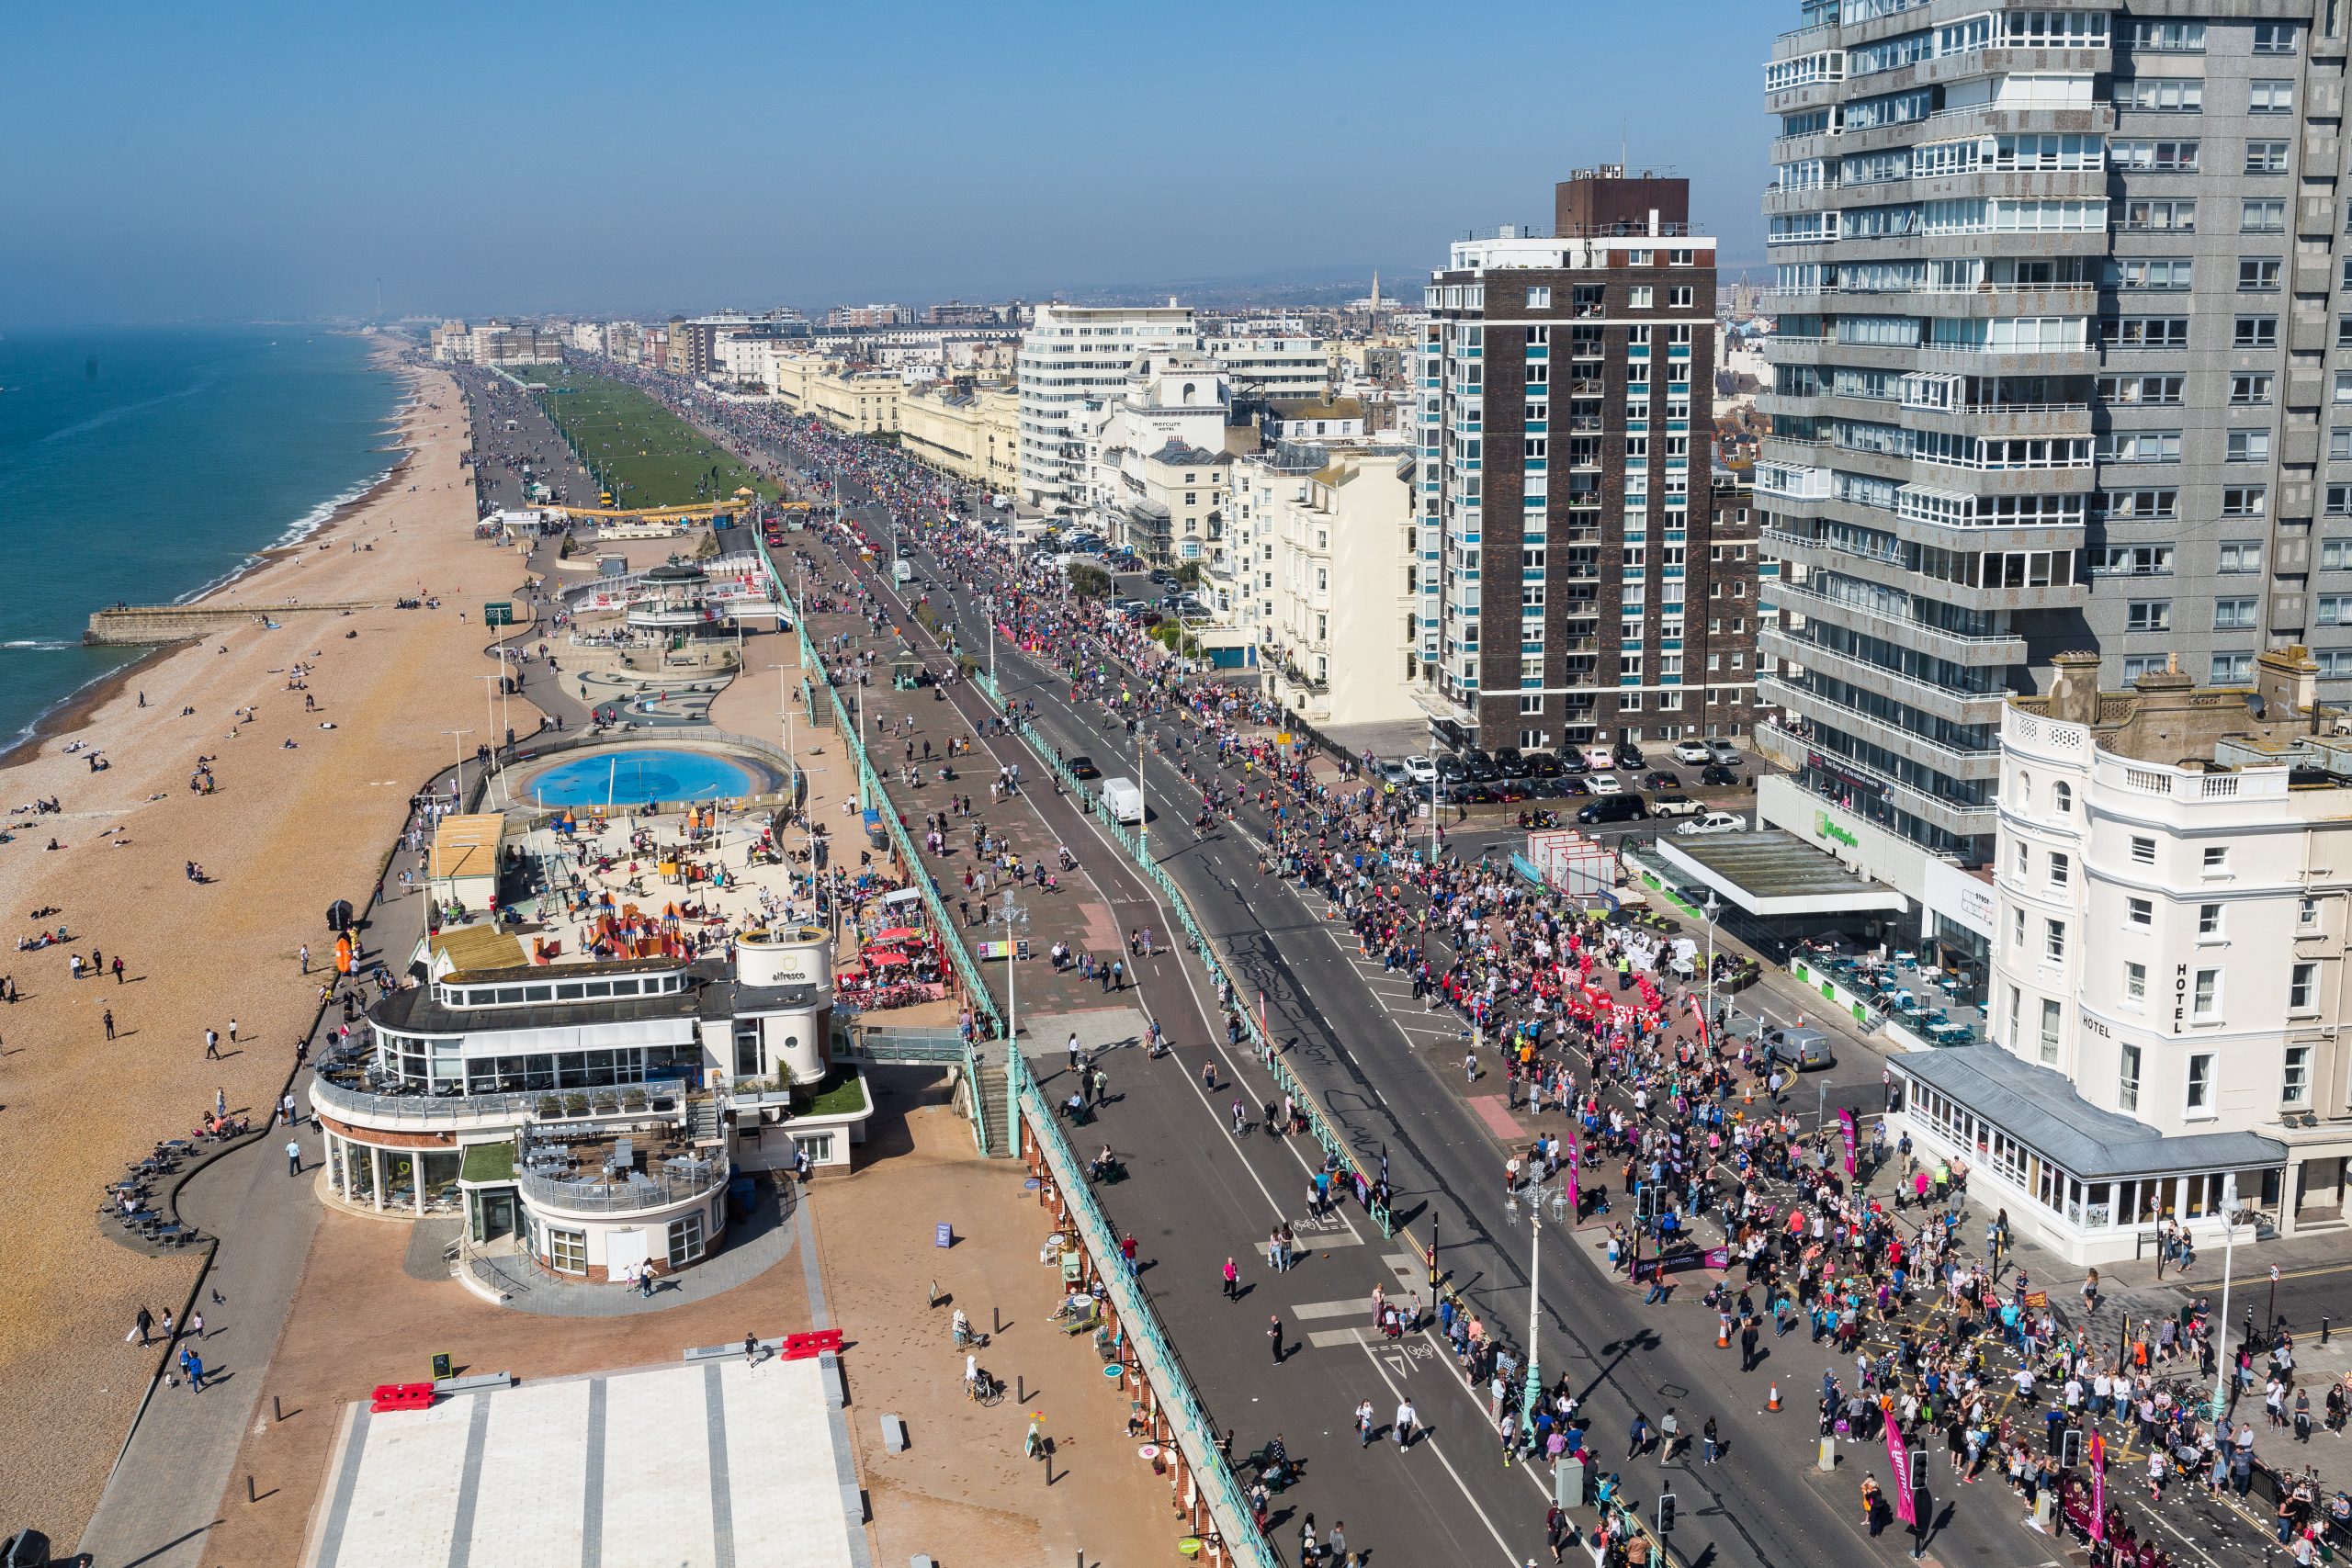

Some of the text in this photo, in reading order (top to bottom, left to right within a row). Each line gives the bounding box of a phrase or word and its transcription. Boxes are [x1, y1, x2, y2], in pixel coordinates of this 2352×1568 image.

[1853, 772, 1866, 783] national
[1865, 777, 1879, 788] awards
[772, 971, 806, 981] alfresco
[2174, 964, 2187, 1034] HOTEL
[2083, 1015, 2111, 1039] HOTEL
[2151, 1200, 2159, 1209] 20
[2270, 1269, 2278, 1278] 20
